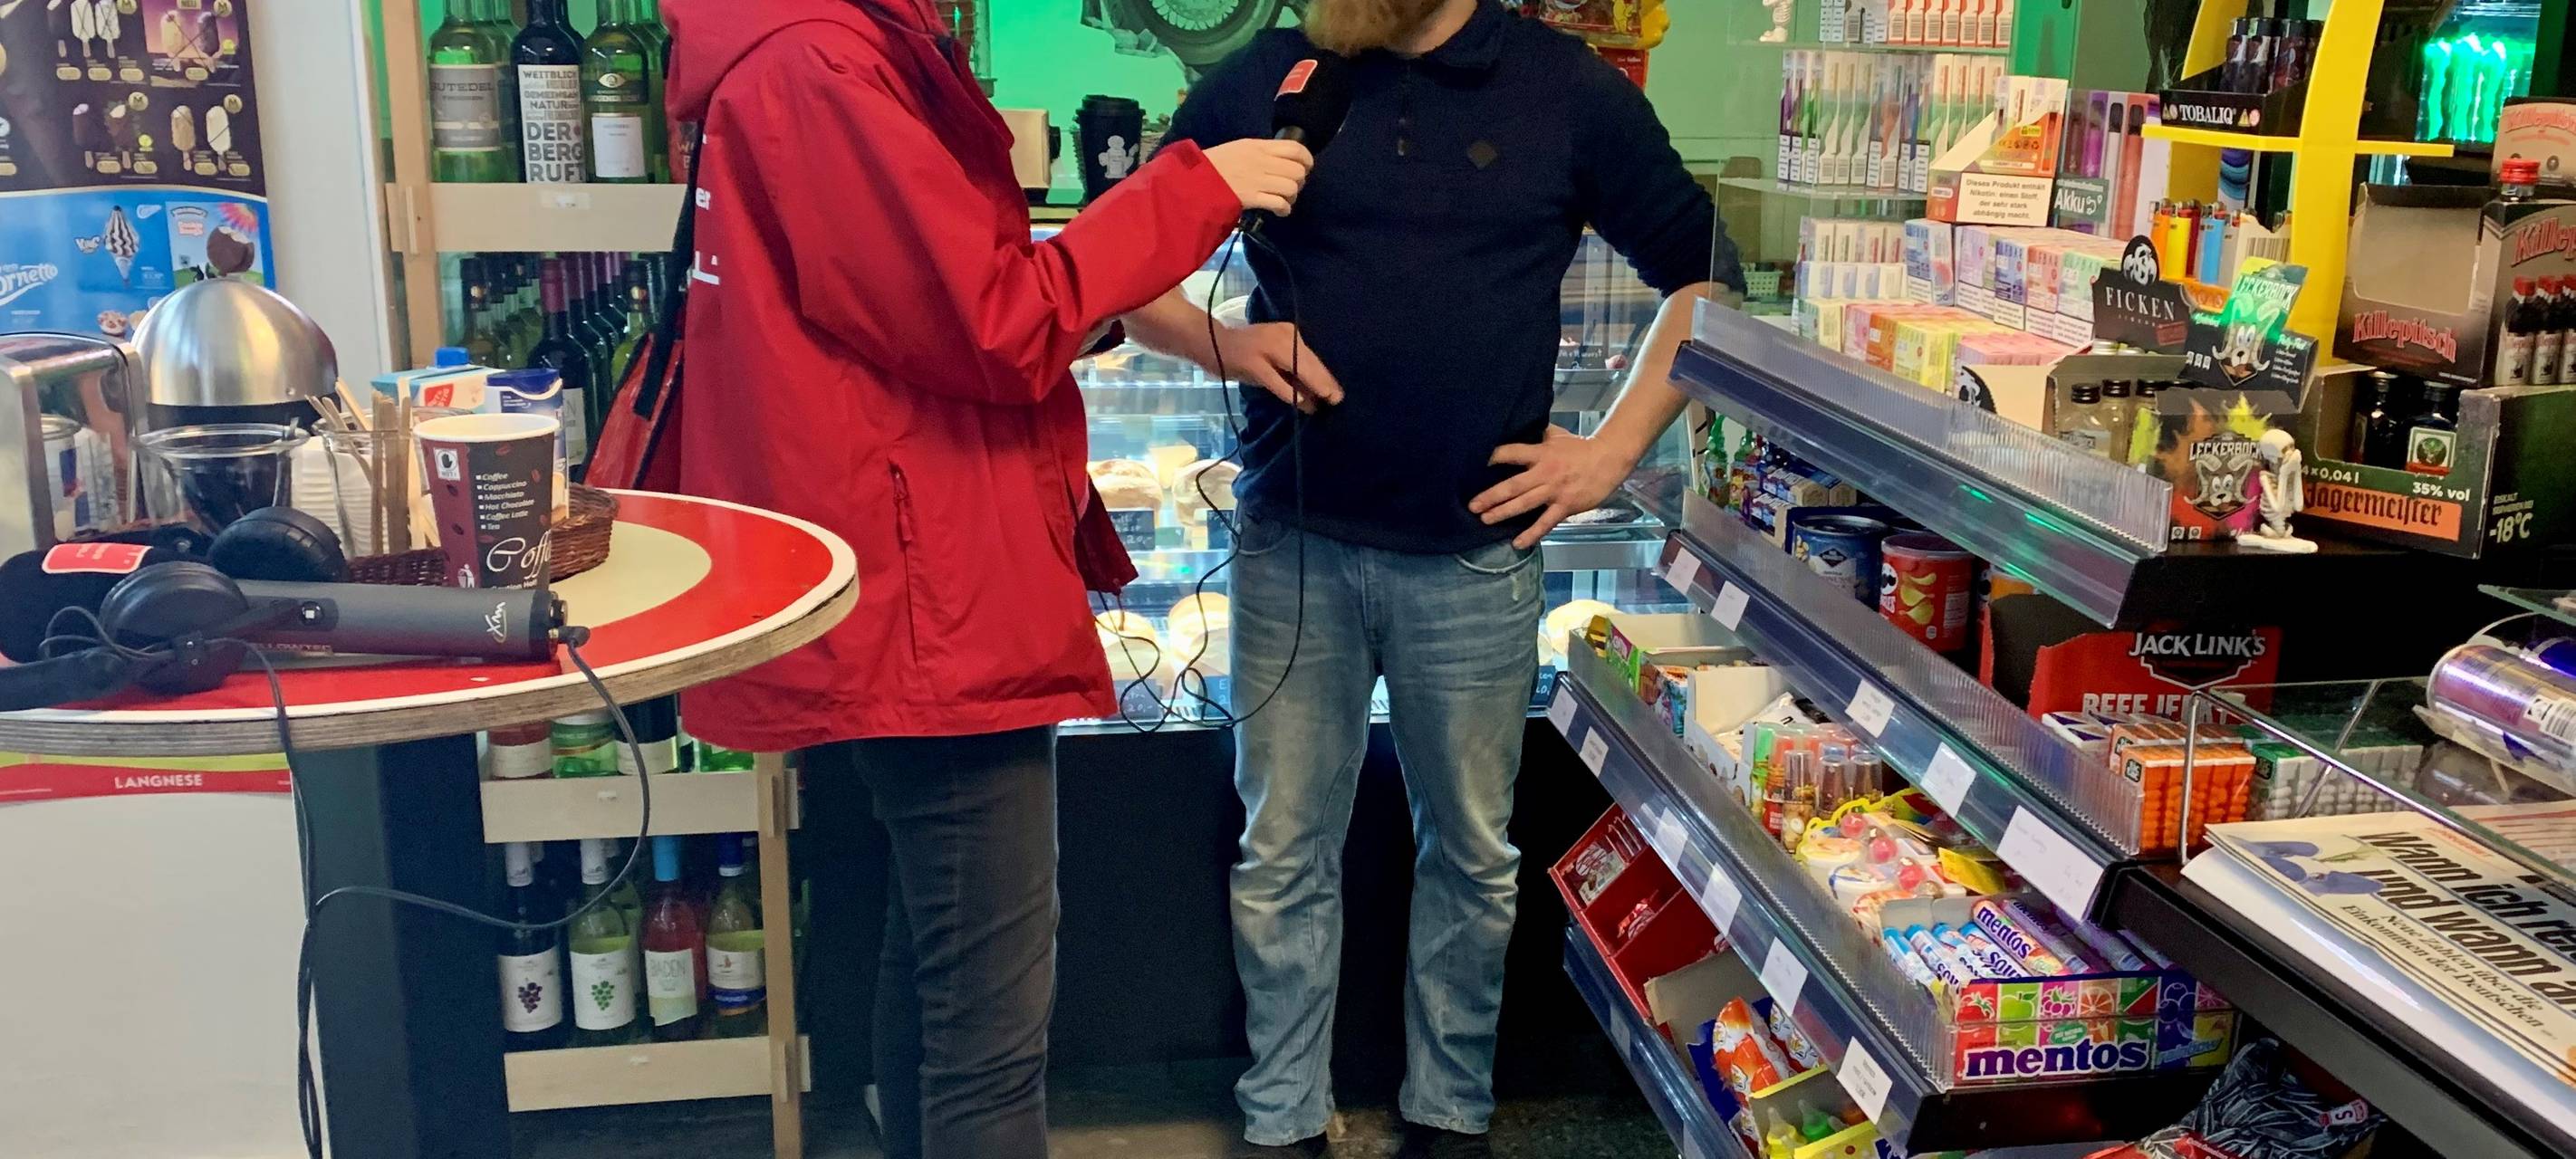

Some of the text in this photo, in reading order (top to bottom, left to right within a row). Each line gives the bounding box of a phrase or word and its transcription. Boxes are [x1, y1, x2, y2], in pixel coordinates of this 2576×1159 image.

[2179, 104, 2233, 125] TOBALIQ
[525, 122, 572, 140] DER
[527, 142, 582, 161] BERG
[1993, 179, 2020, 189] Produkt
[2054, 188, 2085, 214] Akku
[2105, 285, 2176, 321] FICKEN
[2352, 310, 2456, 364] Killepitsch
[482, 473, 509, 482] Coffee
[484, 480, 527, 491] Cappuccino
[484, 491, 524, 501] Macchiato
[2412, 482, 2471, 502] 35% vol
[485, 509, 529, 521] Coffee Latte
[2129, 629, 2266, 657] JACK LINK'S
[114, 773, 203, 789] LANGNESE
[2358, 831, 2483, 882] Wann
[2451, 883, 2551, 918] ich
[1976, 905, 2033, 960] mentos
[2352, 869, 2463, 911] und
[2420, 910, 2562, 977] wann
[2341, 905, 2544, 1029] Einkommen der Deutschen
[2382, 915, 2543, 1011] Neue Zahlen über die
[1966, 1038, 2148, 1077] mentos
